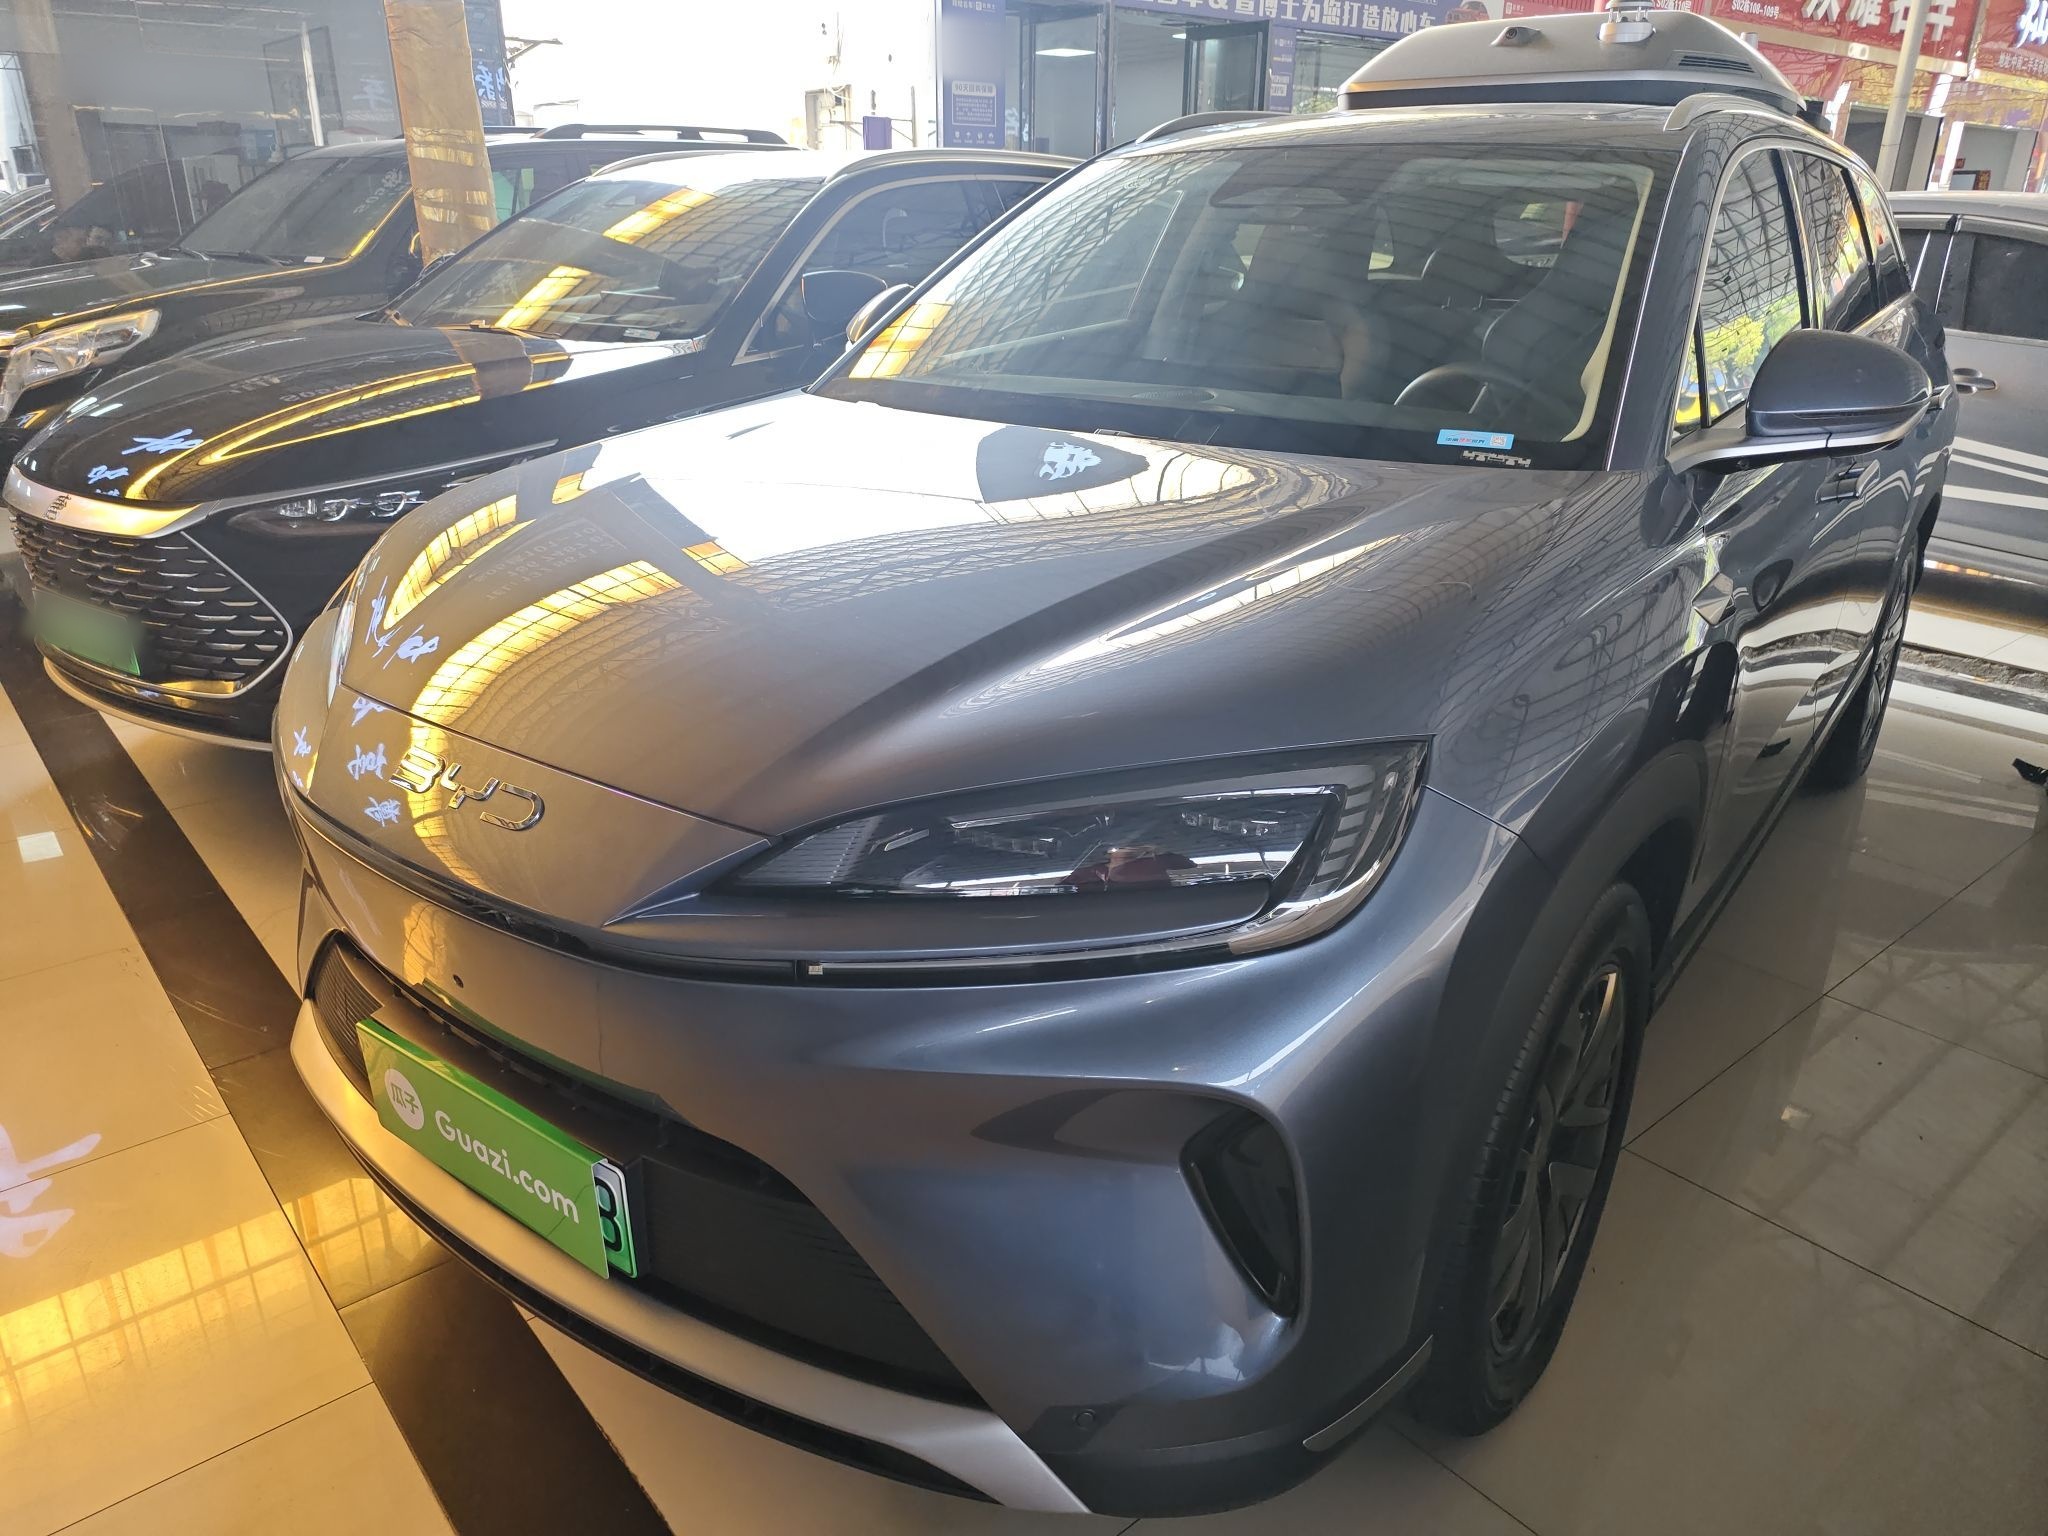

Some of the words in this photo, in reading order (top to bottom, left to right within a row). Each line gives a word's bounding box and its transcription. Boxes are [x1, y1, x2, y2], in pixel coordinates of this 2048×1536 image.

[389, 745, 546, 831] BYD
[390, 1082, 419, 1115] 瓜子
[434, 1110, 579, 1224] Guazi.com
